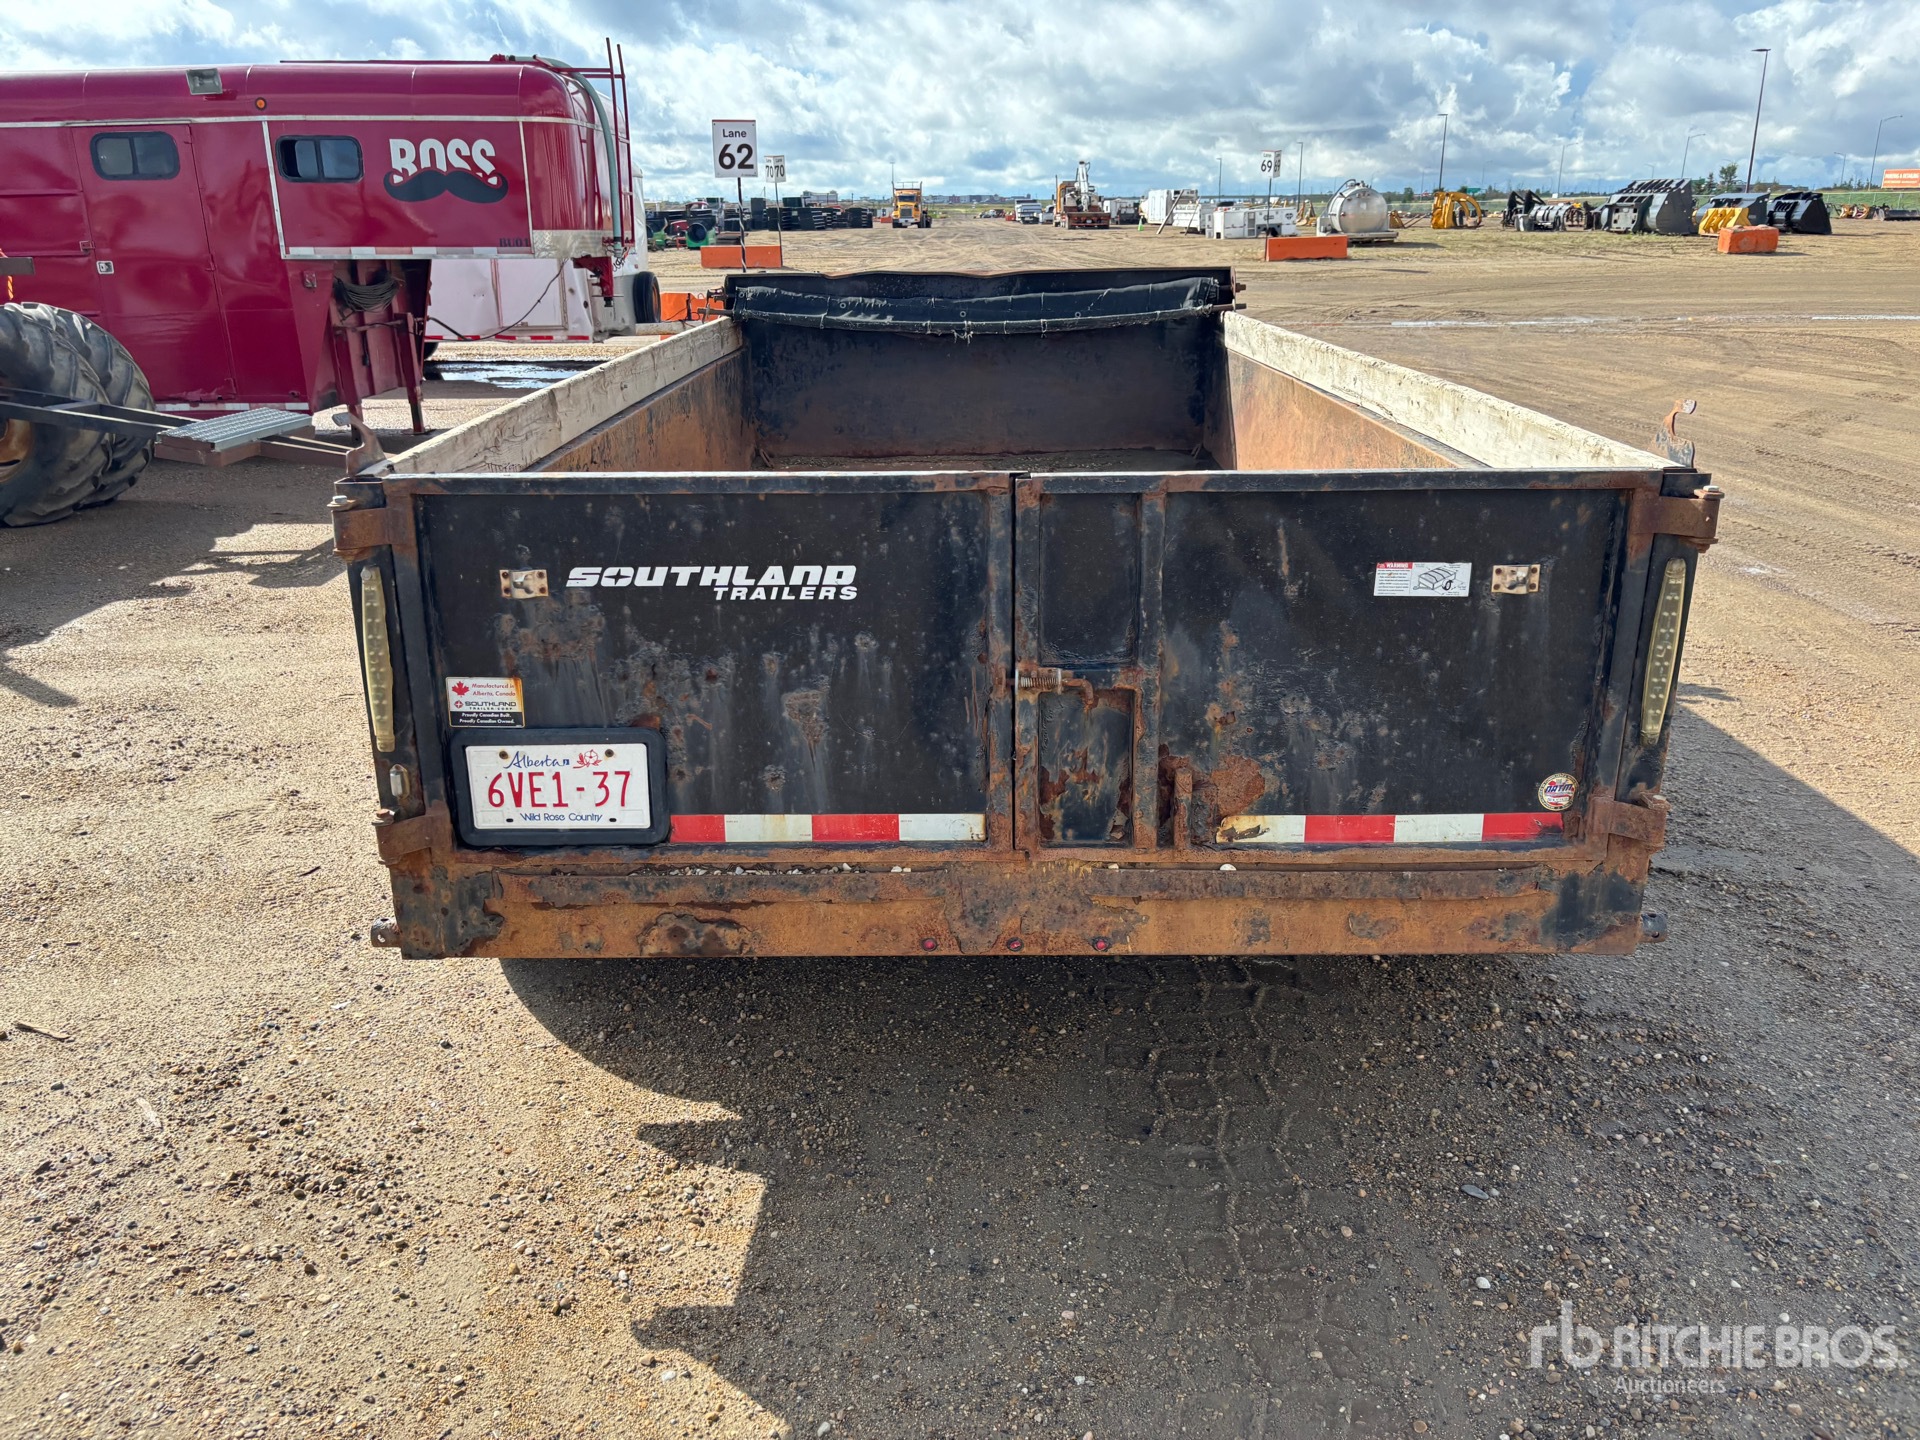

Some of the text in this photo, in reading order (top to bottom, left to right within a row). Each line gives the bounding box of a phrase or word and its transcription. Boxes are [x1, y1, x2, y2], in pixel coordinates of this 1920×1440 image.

[722, 128, 747, 138] Lane
[389, 138, 497, 185] BOSS
[718, 143, 754, 170] 62
[765, 165, 774, 178] 70
[774, 164, 785, 178] 70
[1261, 159, 1272, 172] 69
[565, 565, 857, 587] SOUTHLAND
[713, 586, 858, 600] TRAILERS
[503, 750, 564, 769] Alberta
[488, 771, 632, 808] 6VE1-37
[519, 812, 603, 823] Wild Rose Country
